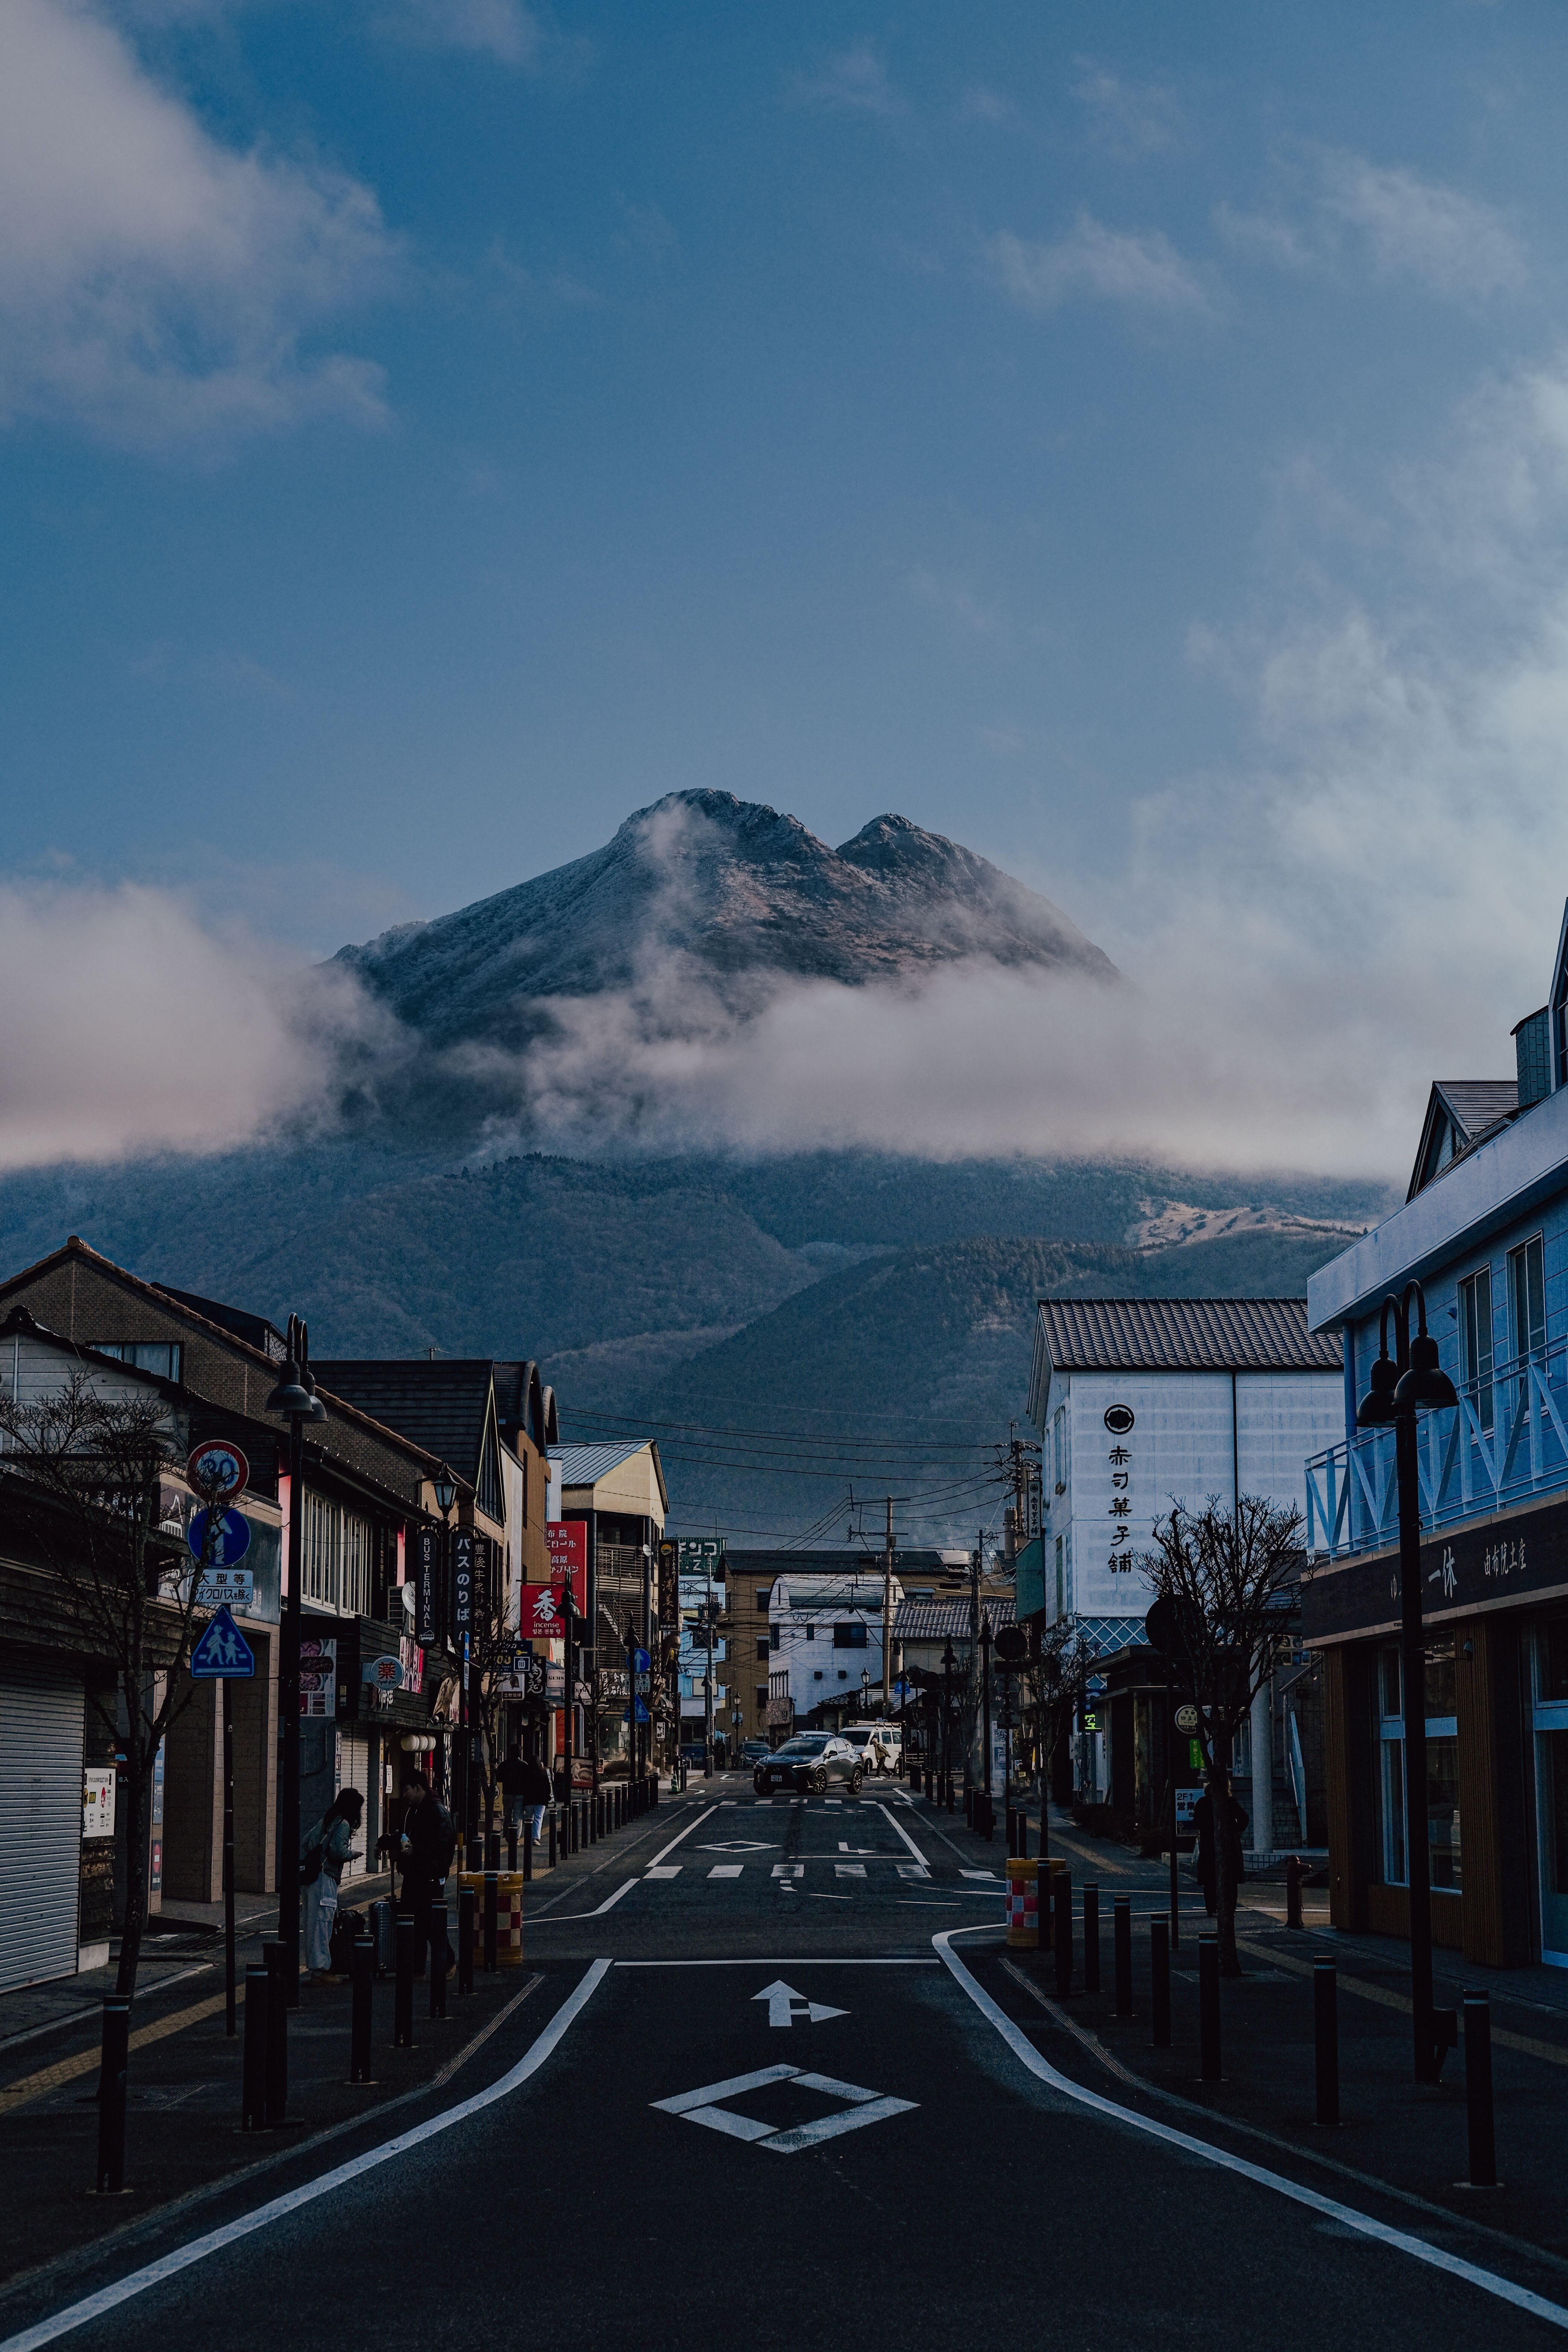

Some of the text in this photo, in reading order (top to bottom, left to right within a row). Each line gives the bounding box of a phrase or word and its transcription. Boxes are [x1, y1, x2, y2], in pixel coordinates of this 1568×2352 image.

[1030, 1496, 1039, 1536] 赤司菓子舗
[1108, 1445, 1133, 1573] 赤司菓子舗
[1428, 1546, 1458, 1598] 一休
[1484, 1537, 1526, 1577] 由布院土産
[199, 1573, 247, 1585] 大型等
[457, 1538, 470, 1621] バスのりば
[531, 1589, 557, 1622] 香
[378, 1661, 396, 1679] 薬
